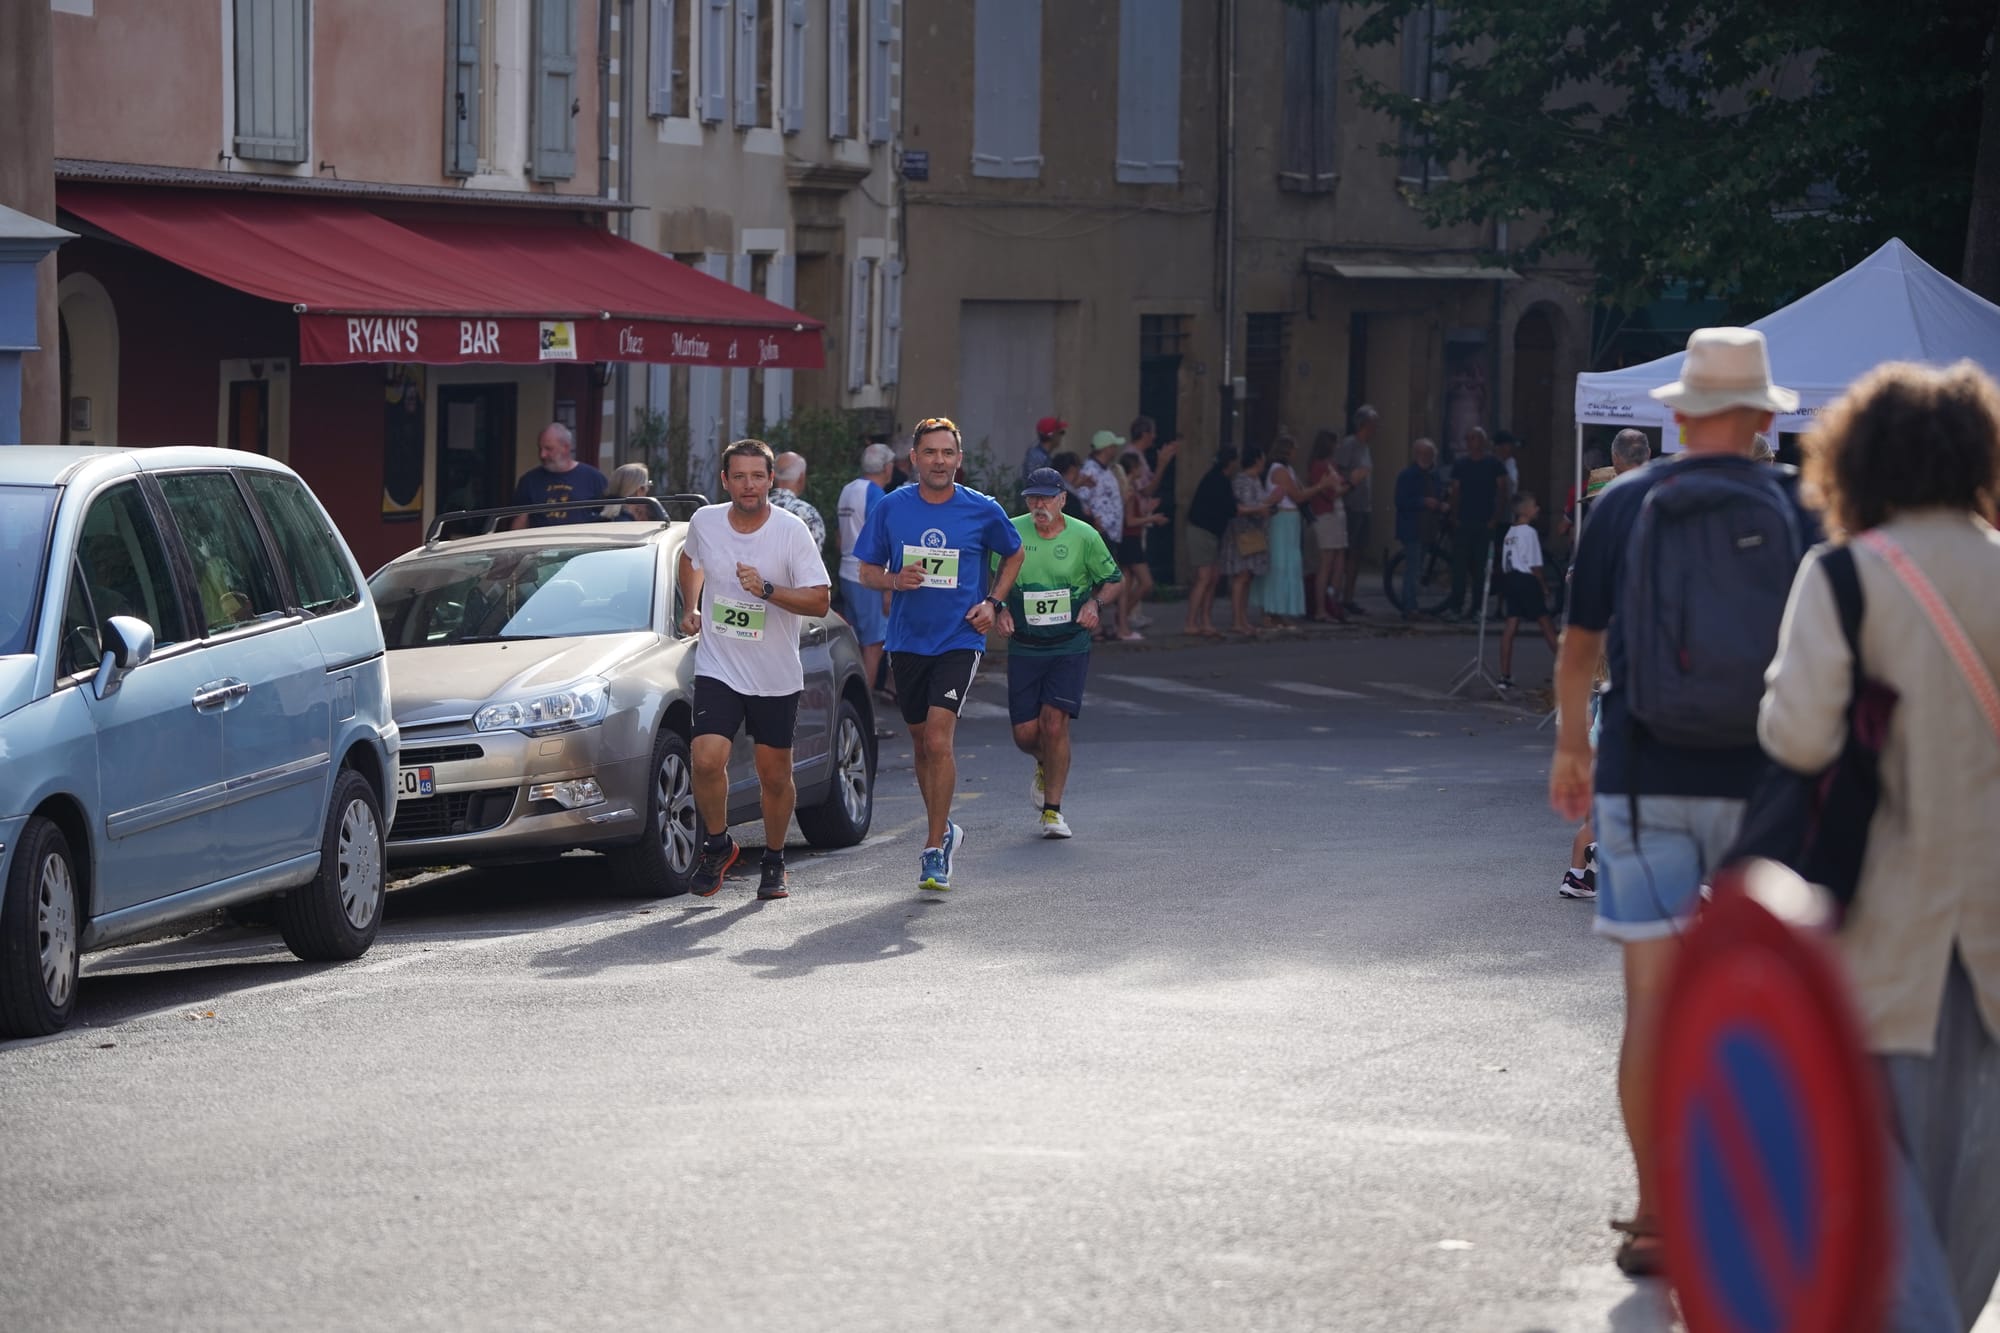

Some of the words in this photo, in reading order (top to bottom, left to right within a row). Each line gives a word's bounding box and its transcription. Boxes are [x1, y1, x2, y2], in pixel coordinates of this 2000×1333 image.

[347, 318, 419, 354] RYAN'S
[459, 320, 500, 354] BAR
[619, 325, 644, 355] Chez
[671, 332, 710, 358] Martine
[728, 338, 738, 359] et
[758, 335, 779, 366] John
[922, 557, 944, 575] 17
[1036, 600, 1058, 615] 87
[724, 608, 750, 628] 29
[421, 782, 432, 793] 48
